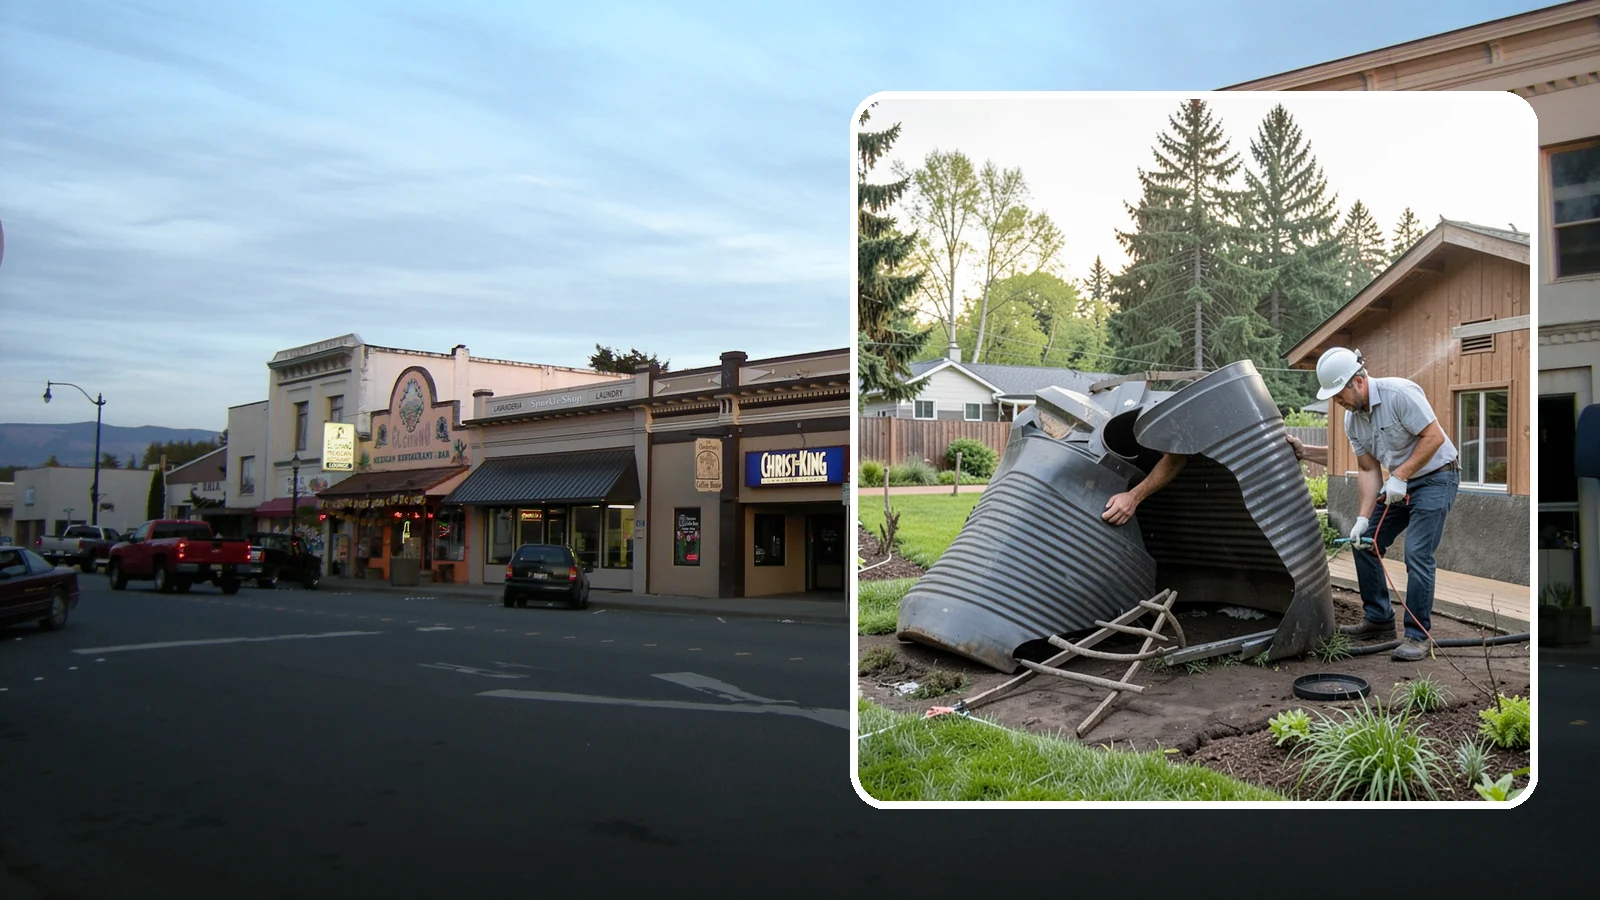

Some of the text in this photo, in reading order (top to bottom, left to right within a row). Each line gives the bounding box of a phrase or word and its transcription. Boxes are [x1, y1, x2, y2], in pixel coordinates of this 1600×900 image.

[595, 388, 624, 400] LAUNDRY
[493, 402, 523, 412] LAVANDERIA
[530, 395, 583, 409] Sparkle Shop
[373, 453, 396, 464] MEXICAN
[397, 450, 433, 462] RESTAURANT
[438, 450, 450, 459] BAR
[760, 449, 827, 478] CHRIST KING
